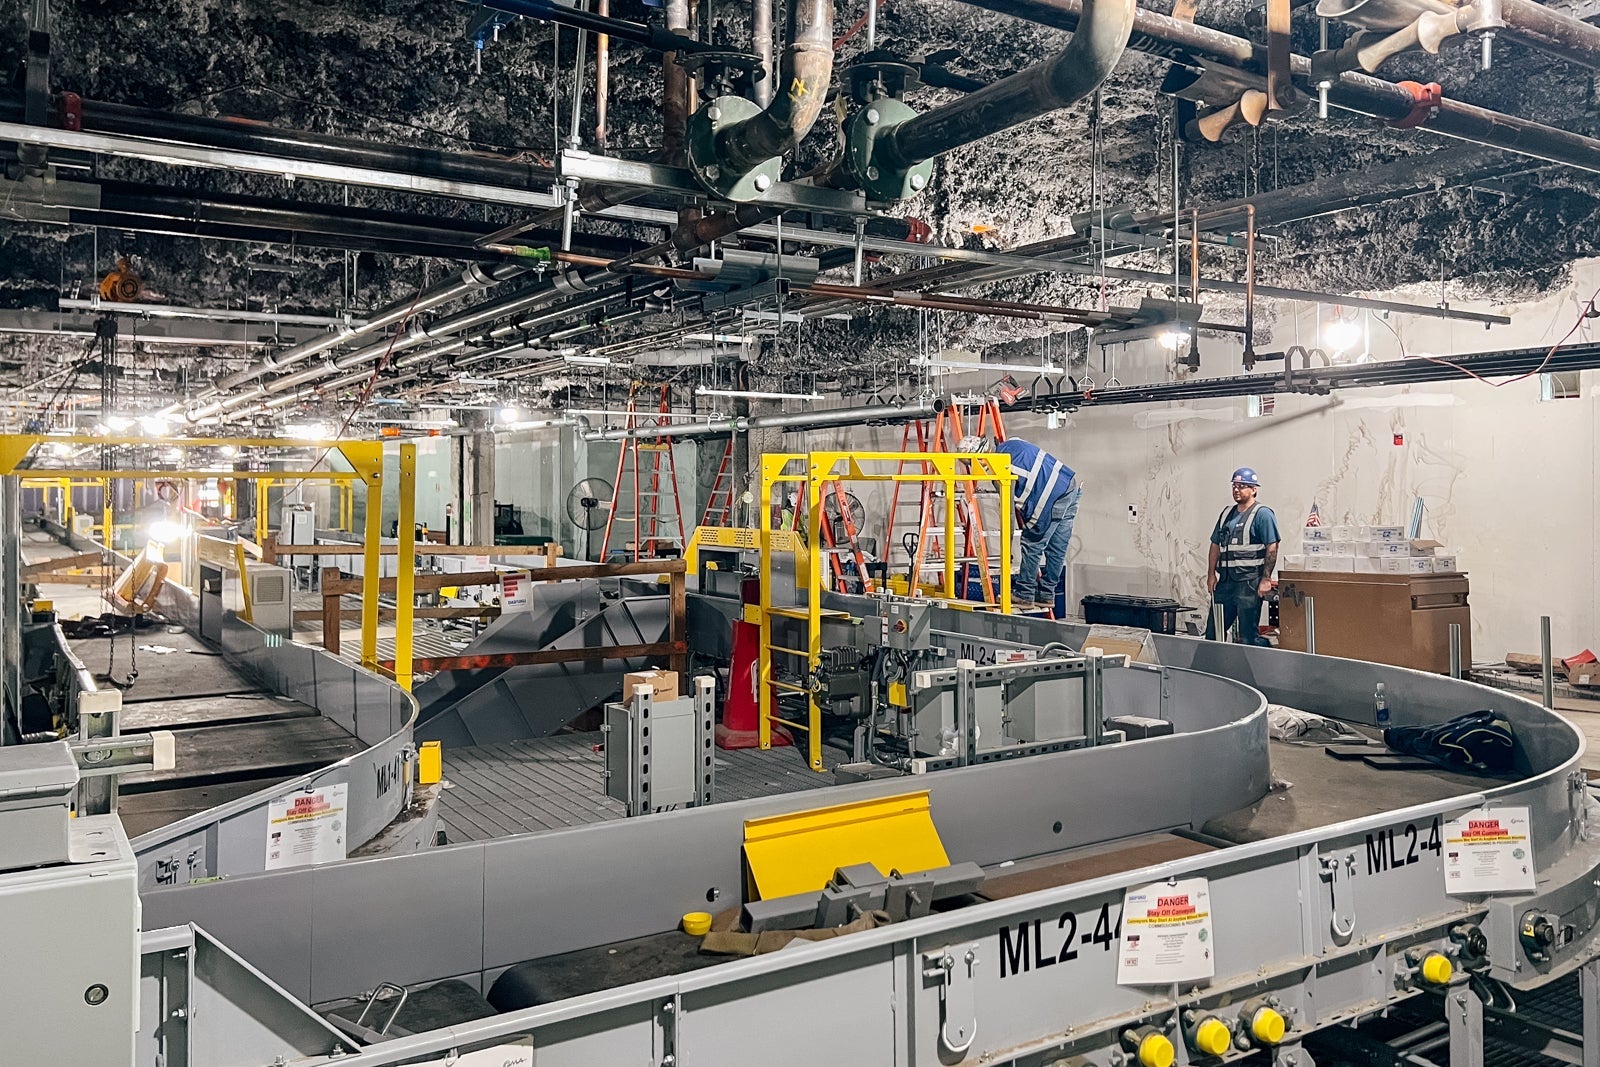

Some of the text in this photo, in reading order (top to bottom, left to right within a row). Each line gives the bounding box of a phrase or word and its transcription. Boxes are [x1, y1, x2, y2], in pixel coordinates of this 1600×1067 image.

[295, 795, 324, 807] DANGER
[1468, 820, 1499, 829] DANGER
[1157, 896, 1189, 907] DANGER
[1147, 909, 1160, 917] Stay
